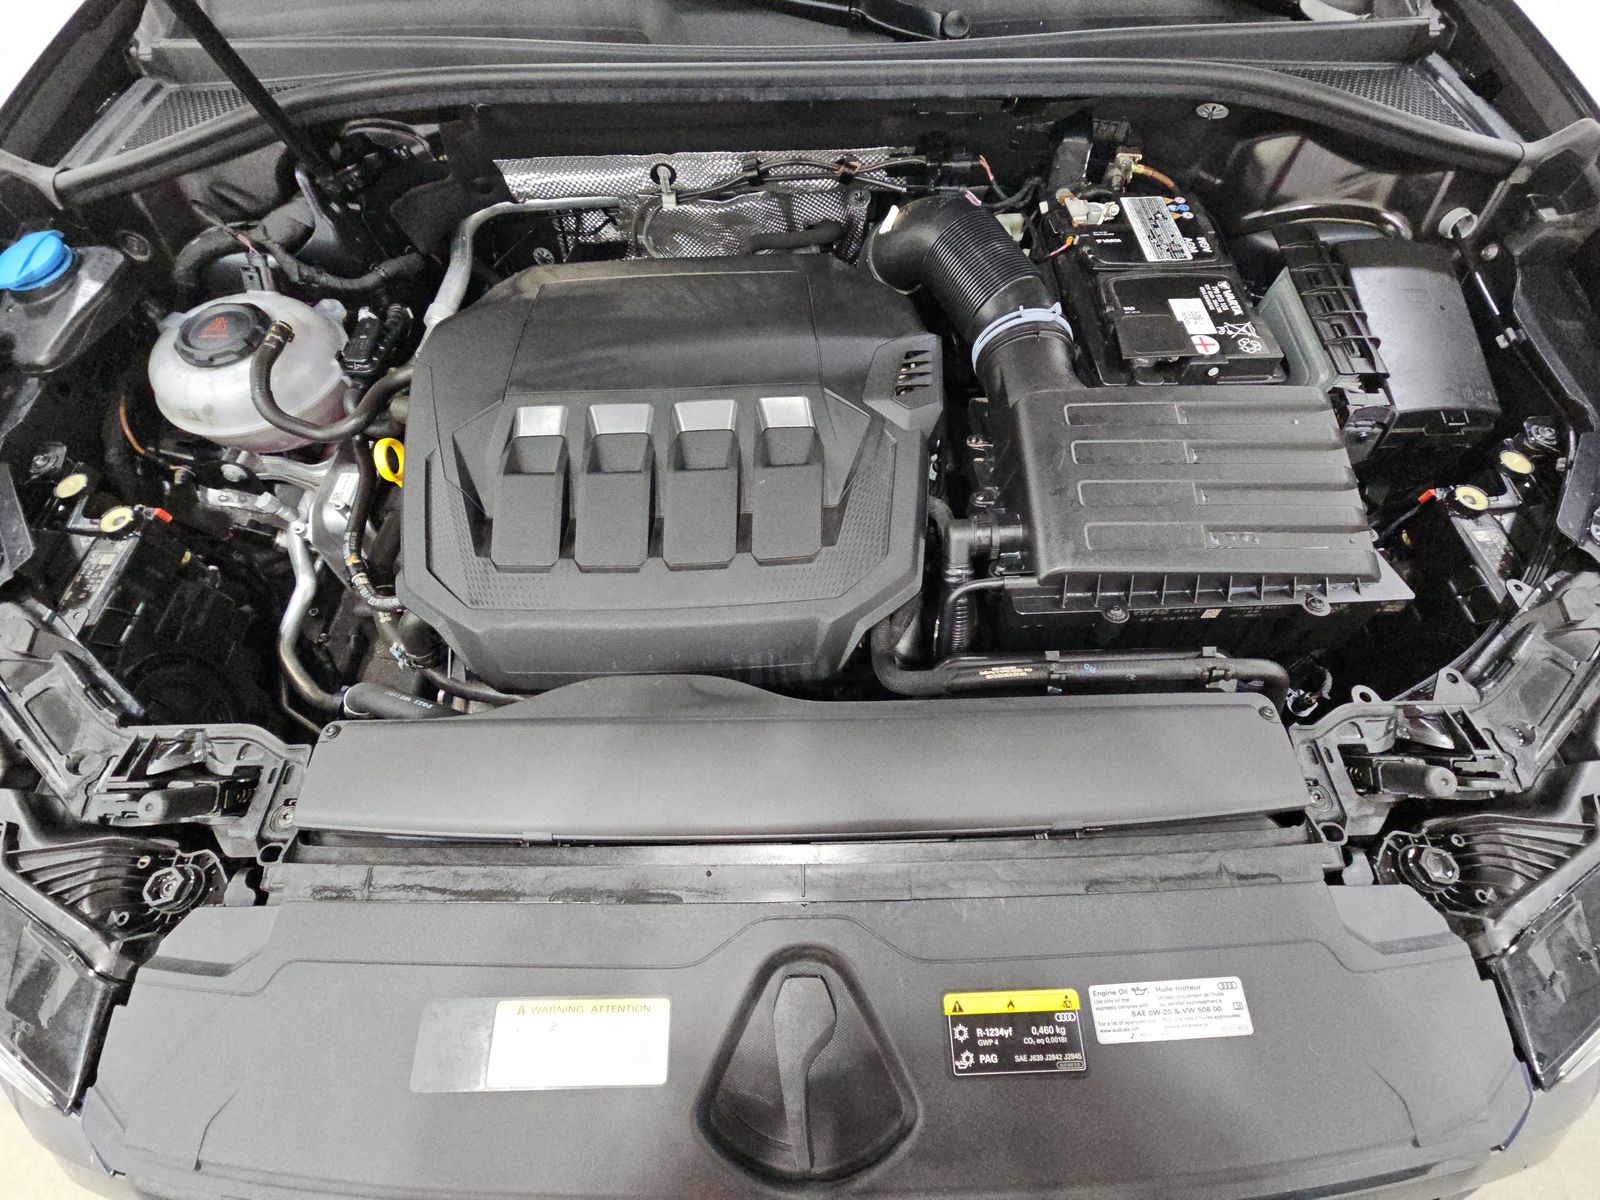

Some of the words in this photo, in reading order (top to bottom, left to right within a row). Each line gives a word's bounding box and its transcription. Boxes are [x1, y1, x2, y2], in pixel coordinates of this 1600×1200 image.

[1222, 290, 1244, 316] VARTA
[530, 1005, 584, 1014] WARNING
[590, 1004, 651, 1013] ATTENTION
[976, 1026, 1013, 1038] R-1234yf
[1031, 1026, 1054, 1036] 0,460
[1055, 1025, 1066, 1035] kg
[979, 1054, 998, 1064] PAG
